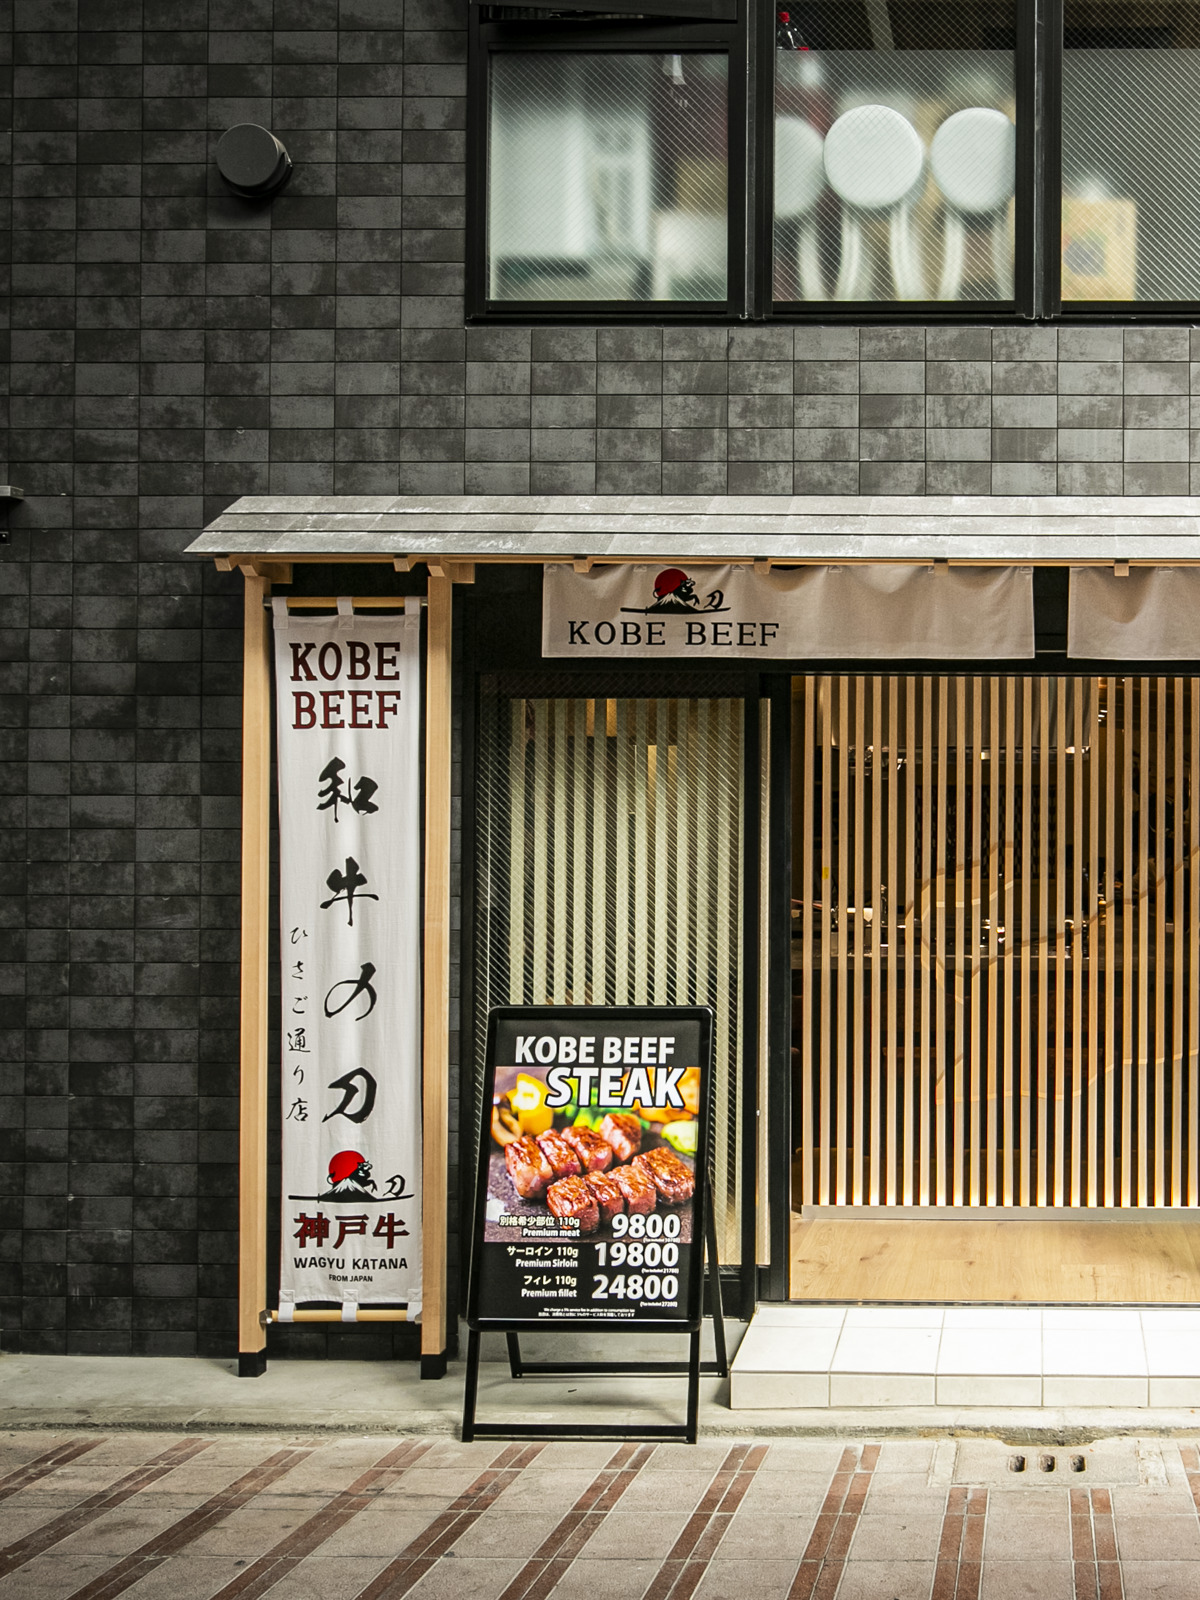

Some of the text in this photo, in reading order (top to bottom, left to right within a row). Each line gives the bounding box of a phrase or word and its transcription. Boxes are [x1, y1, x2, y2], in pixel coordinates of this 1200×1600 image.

[568, 621, 780, 647] KOBE BEEF
[289, 641, 401, 681] KOBE
[292, 690, 401, 730] BEEF
[316, 756, 379, 1123] 和牛の刀
[286, 926, 311, 1122] ひさご通り店
[515, 1036, 675, 1064] KOBE BEEF
[545, 1067, 687, 1108] STEAK
[293, 1212, 410, 1250] 神戸牛
[499, 1215, 580, 1228] 別格希少部位 110g
[522, 1228, 580, 1237] Premium meat
[612, 1213, 681, 1239] 9800
[293, 1257, 408, 1270] WAGYU KATANA
[507, 1246, 579, 1257] サーロイン 110g
[515, 1258, 578, 1267] Premium Sirloin
[594, 1242, 679, 1267] 19800
[329, 1273, 373, 1282] FROM JAPAN
[523, 1275, 577, 1286] フィレ 110g
[591, 1274, 679, 1300] 24800
[521, 1288, 577, 1298] Premium fillet
